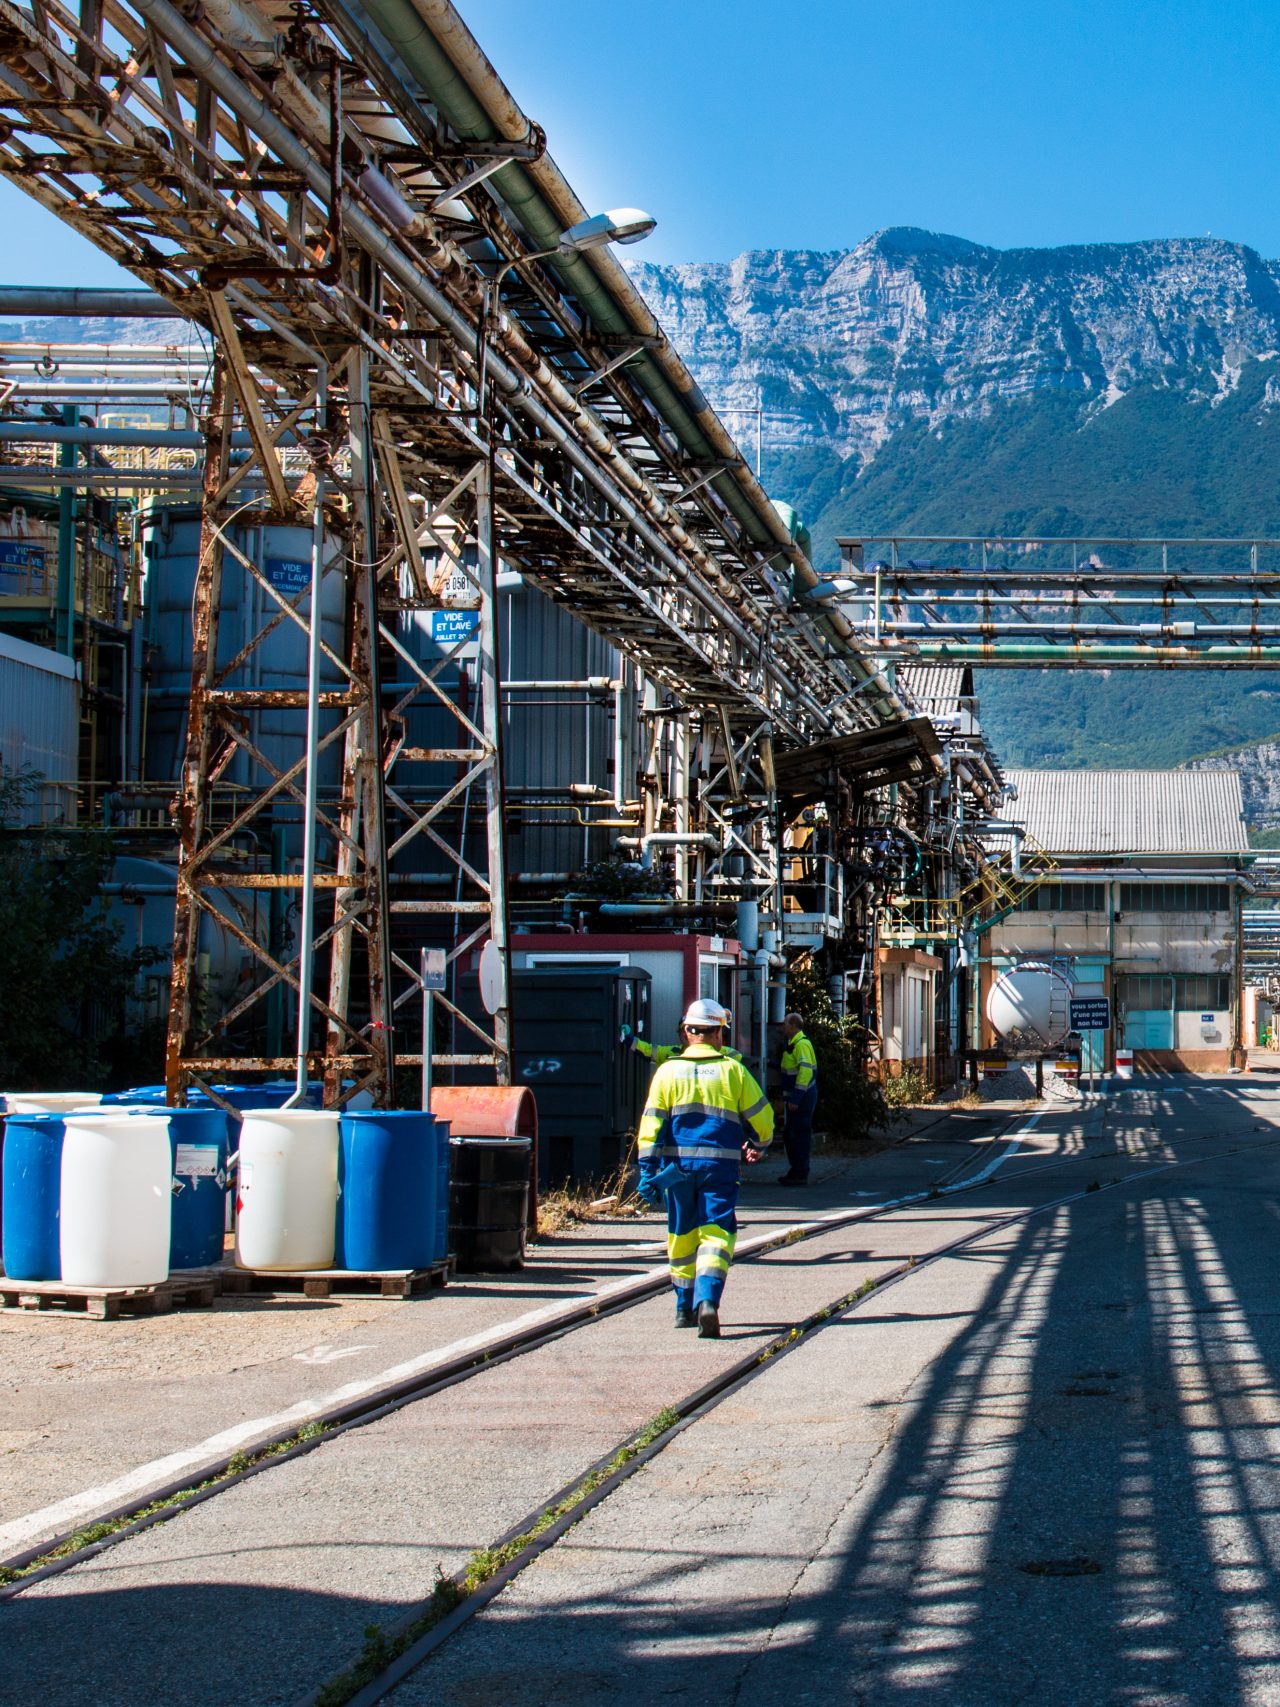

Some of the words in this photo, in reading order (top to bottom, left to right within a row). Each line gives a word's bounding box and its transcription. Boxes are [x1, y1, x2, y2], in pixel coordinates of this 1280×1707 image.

[5, 554, 18, 564] ET
[282, 563, 302, 572] VIDE
[273, 571, 284, 579] ET
[443, 613, 463, 621] VIDE
[436, 623, 447, 631] ET
[449, 620, 472, 630] LAVÉ
